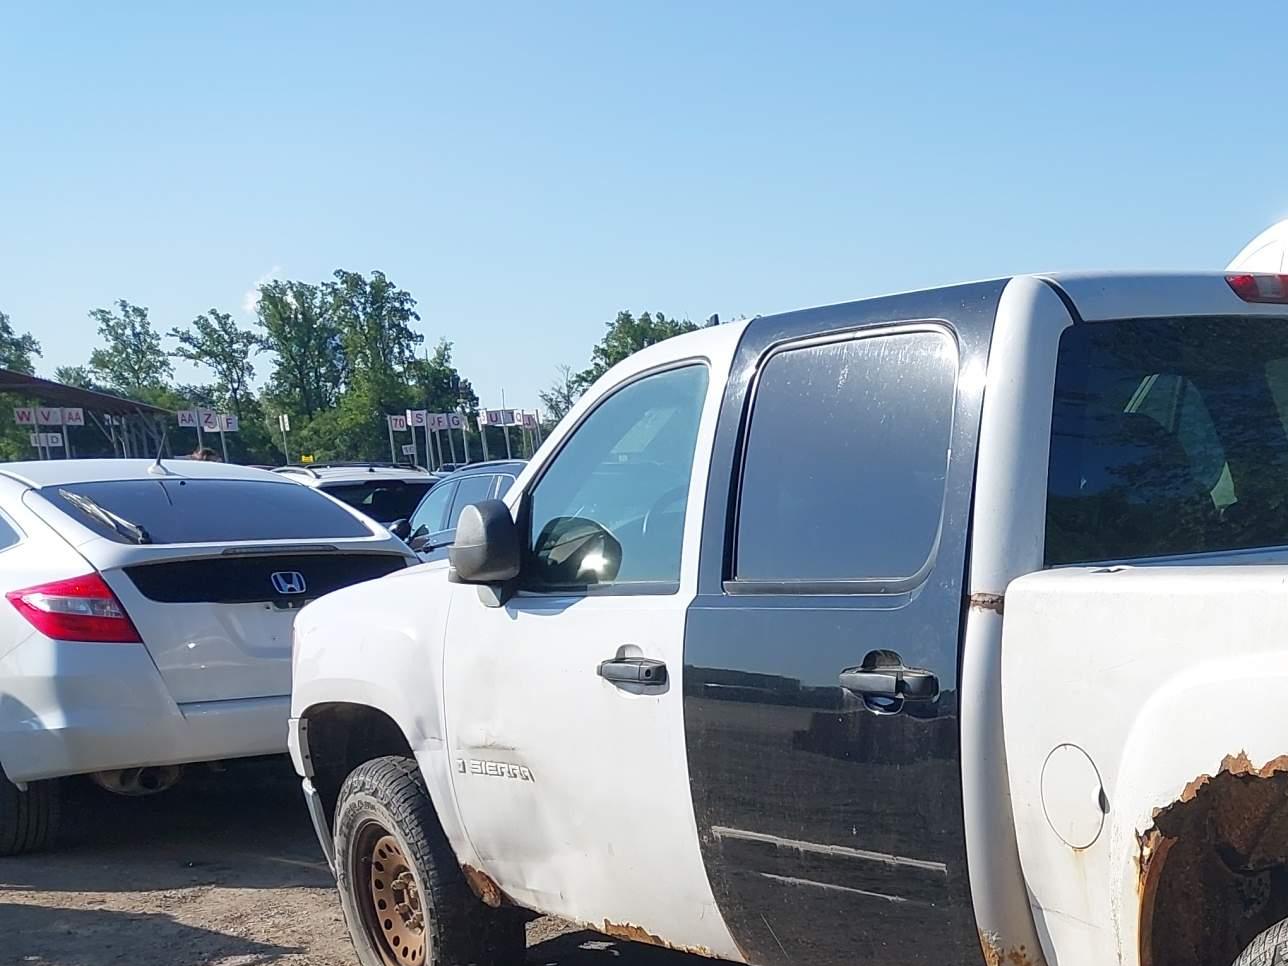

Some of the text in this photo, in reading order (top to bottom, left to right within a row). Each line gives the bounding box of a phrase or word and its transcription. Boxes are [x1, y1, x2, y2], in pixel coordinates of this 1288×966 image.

[16, 410, 31, 422] W
[40, 410, 50, 422] V
[67, 412, 82, 421] AA
[180, 413, 193, 423] AA
[203, 413, 212, 423] Z
[415, 413, 424, 424] S
[451, 415, 460, 426] G
[490, 413, 498, 422] U
[225, 417, 233, 429] F
[392, 417, 405, 429] 70
[469, 758, 536, 784] SIERRA
